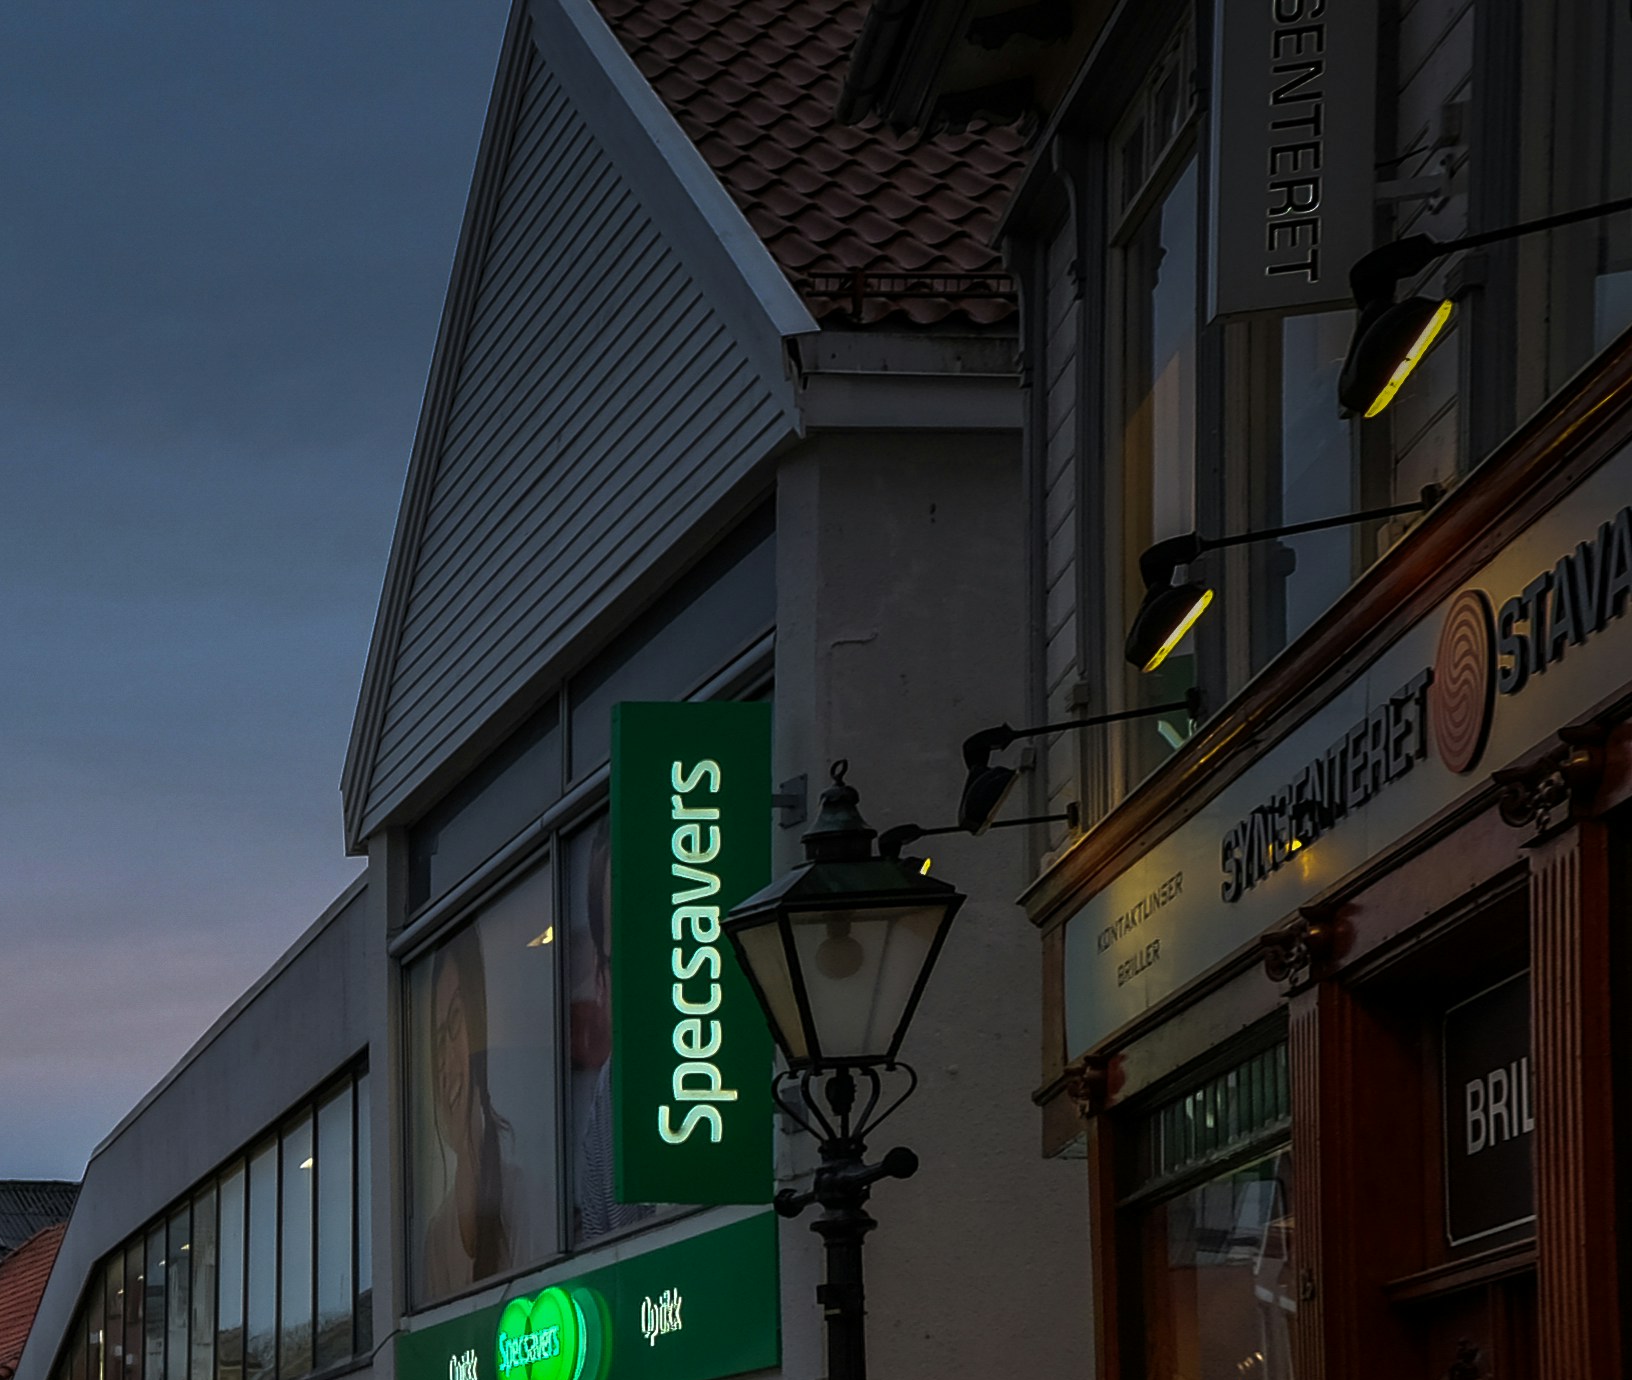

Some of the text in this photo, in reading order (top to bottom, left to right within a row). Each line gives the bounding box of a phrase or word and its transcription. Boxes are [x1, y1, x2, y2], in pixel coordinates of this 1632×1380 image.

[1220, 666, 1434, 902] SYNSENTERET
[657, 757, 738, 1145] Specsavers
[1097, 870, 1184, 954] KONTAKTLINSER
